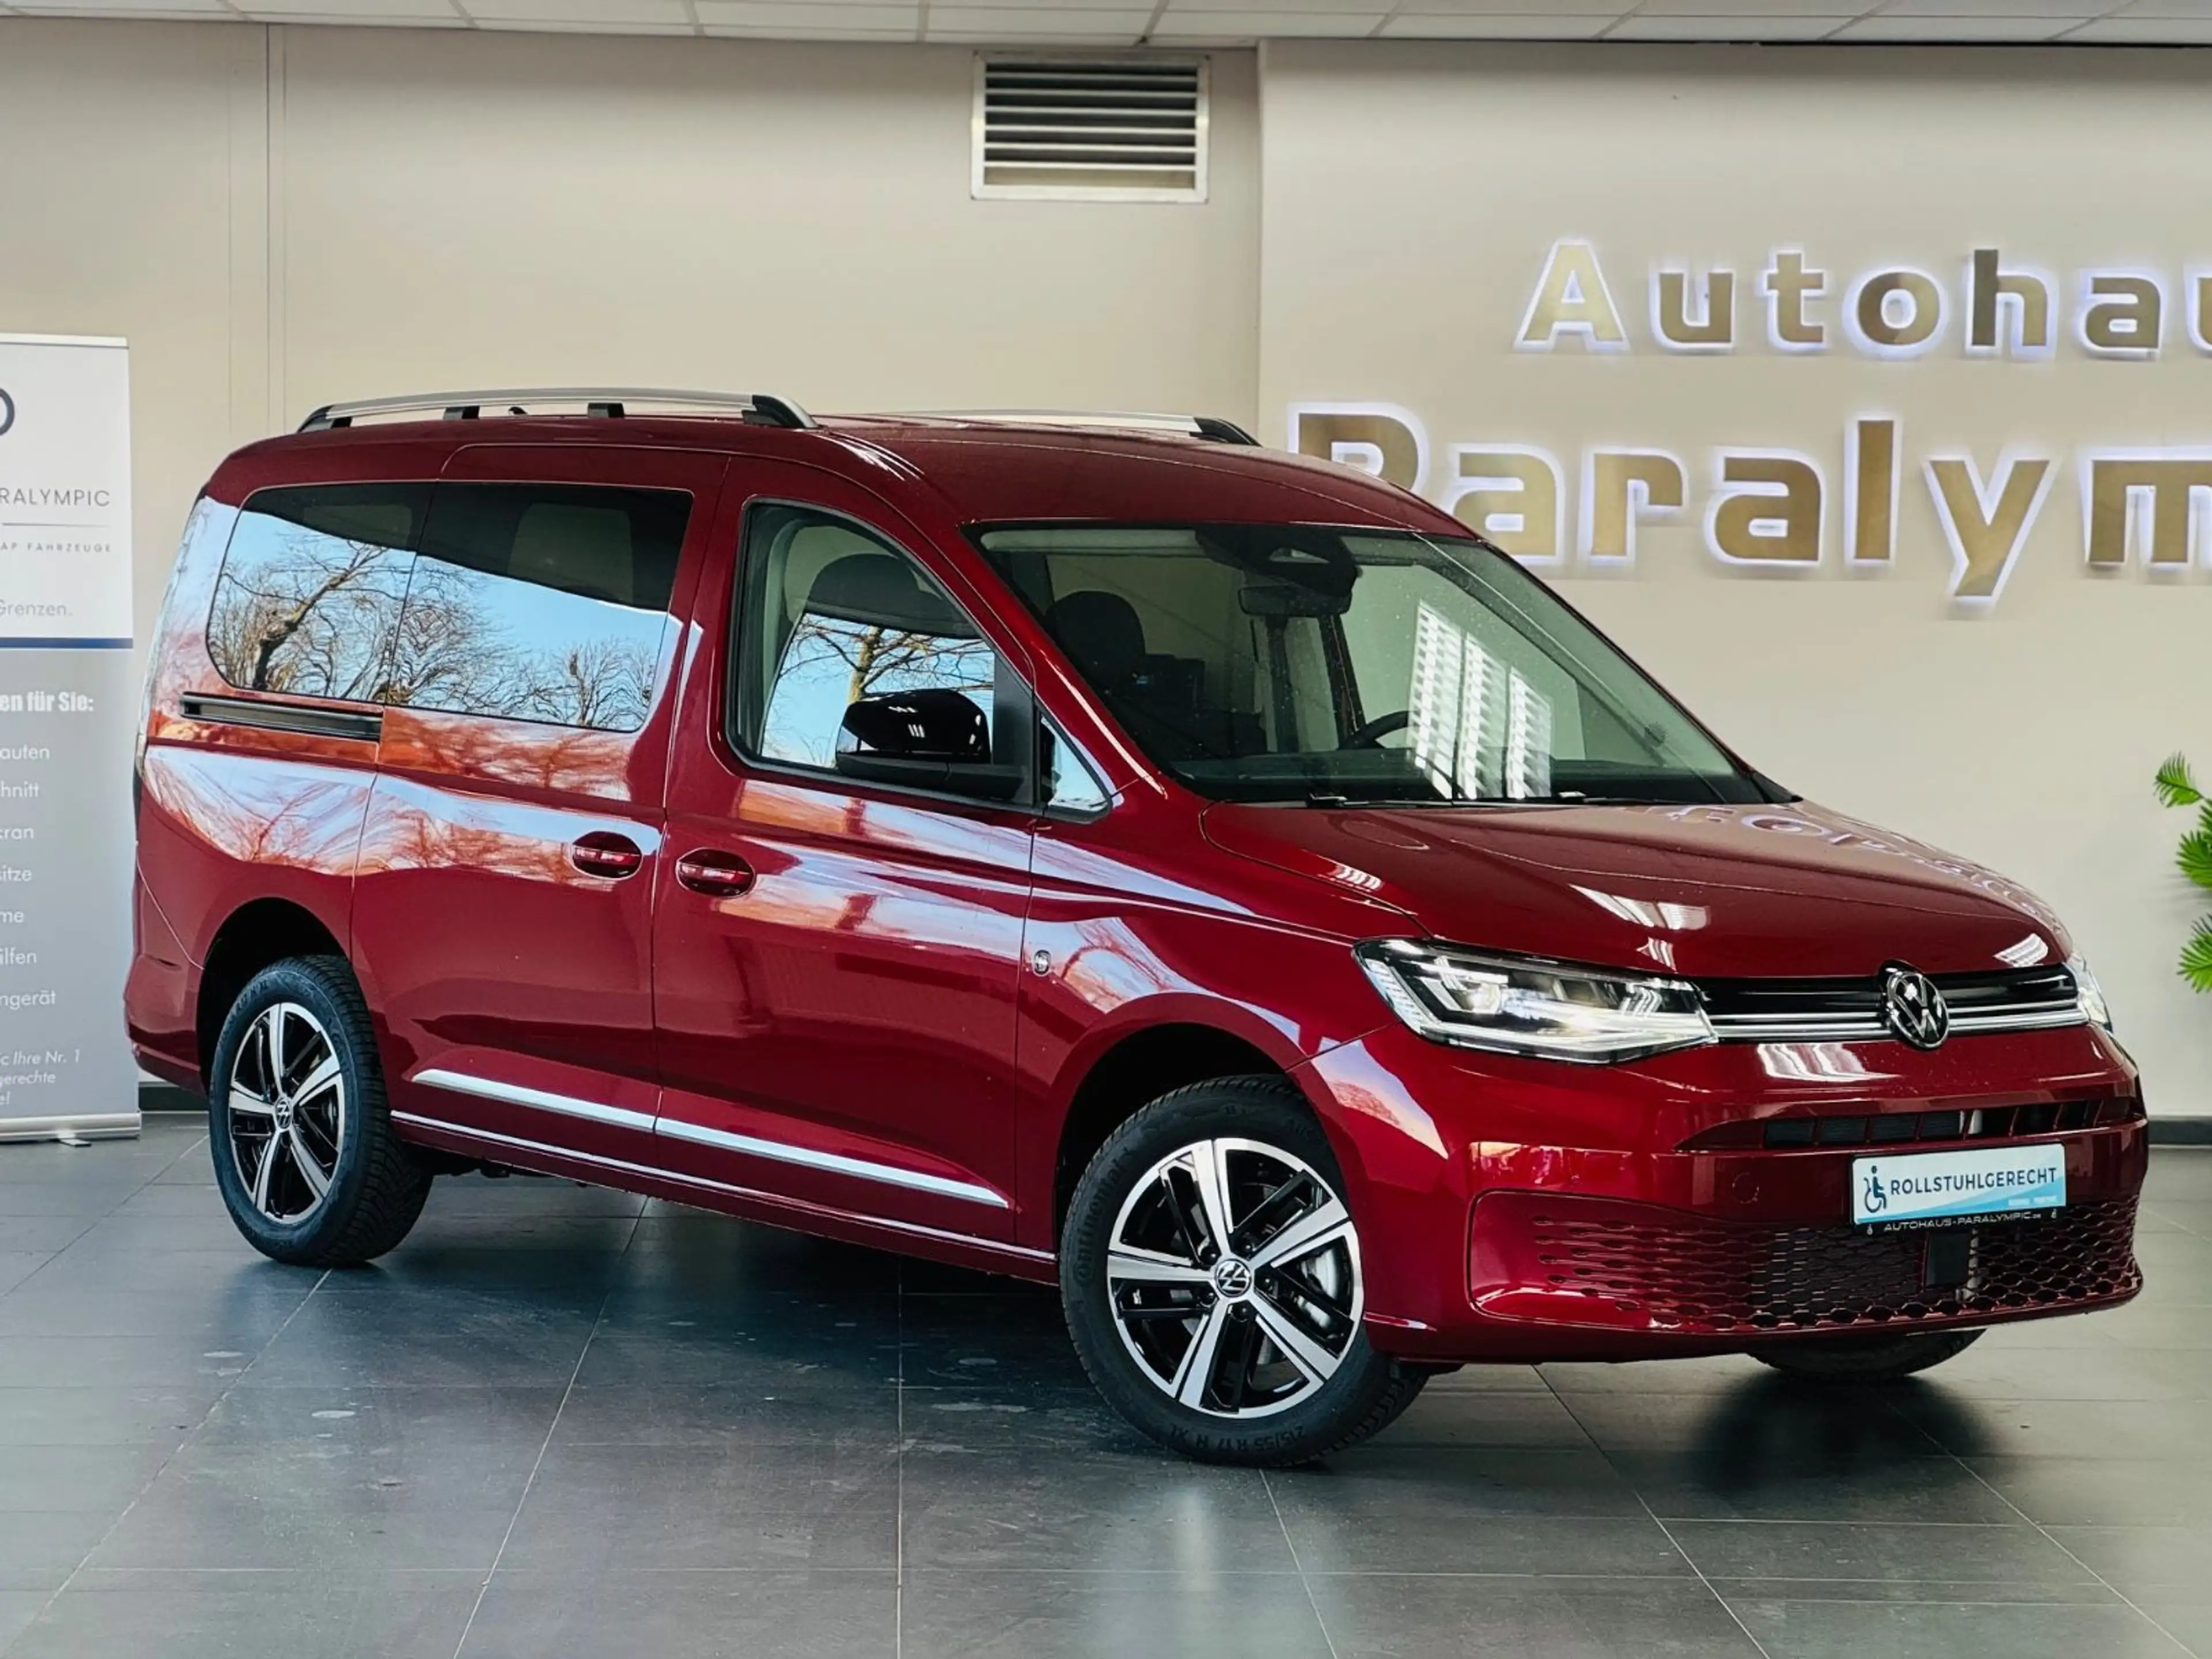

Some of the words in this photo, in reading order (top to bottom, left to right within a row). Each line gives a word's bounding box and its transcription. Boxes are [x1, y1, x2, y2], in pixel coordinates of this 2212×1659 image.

[1517, 240, 2212, 353] Autoha
[27, 542, 112, 552] FAHRZEUGE
[26, 691, 55, 712] für
[58, 691, 94, 713] Sie:
[13, 1050, 41, 1065] Ihre
[45, 1049, 67, 1065] Nr.
[74, 1048, 81, 1063] 1
[1890, 1167, 2057, 1195] ROLLSTUHLGERECHT
